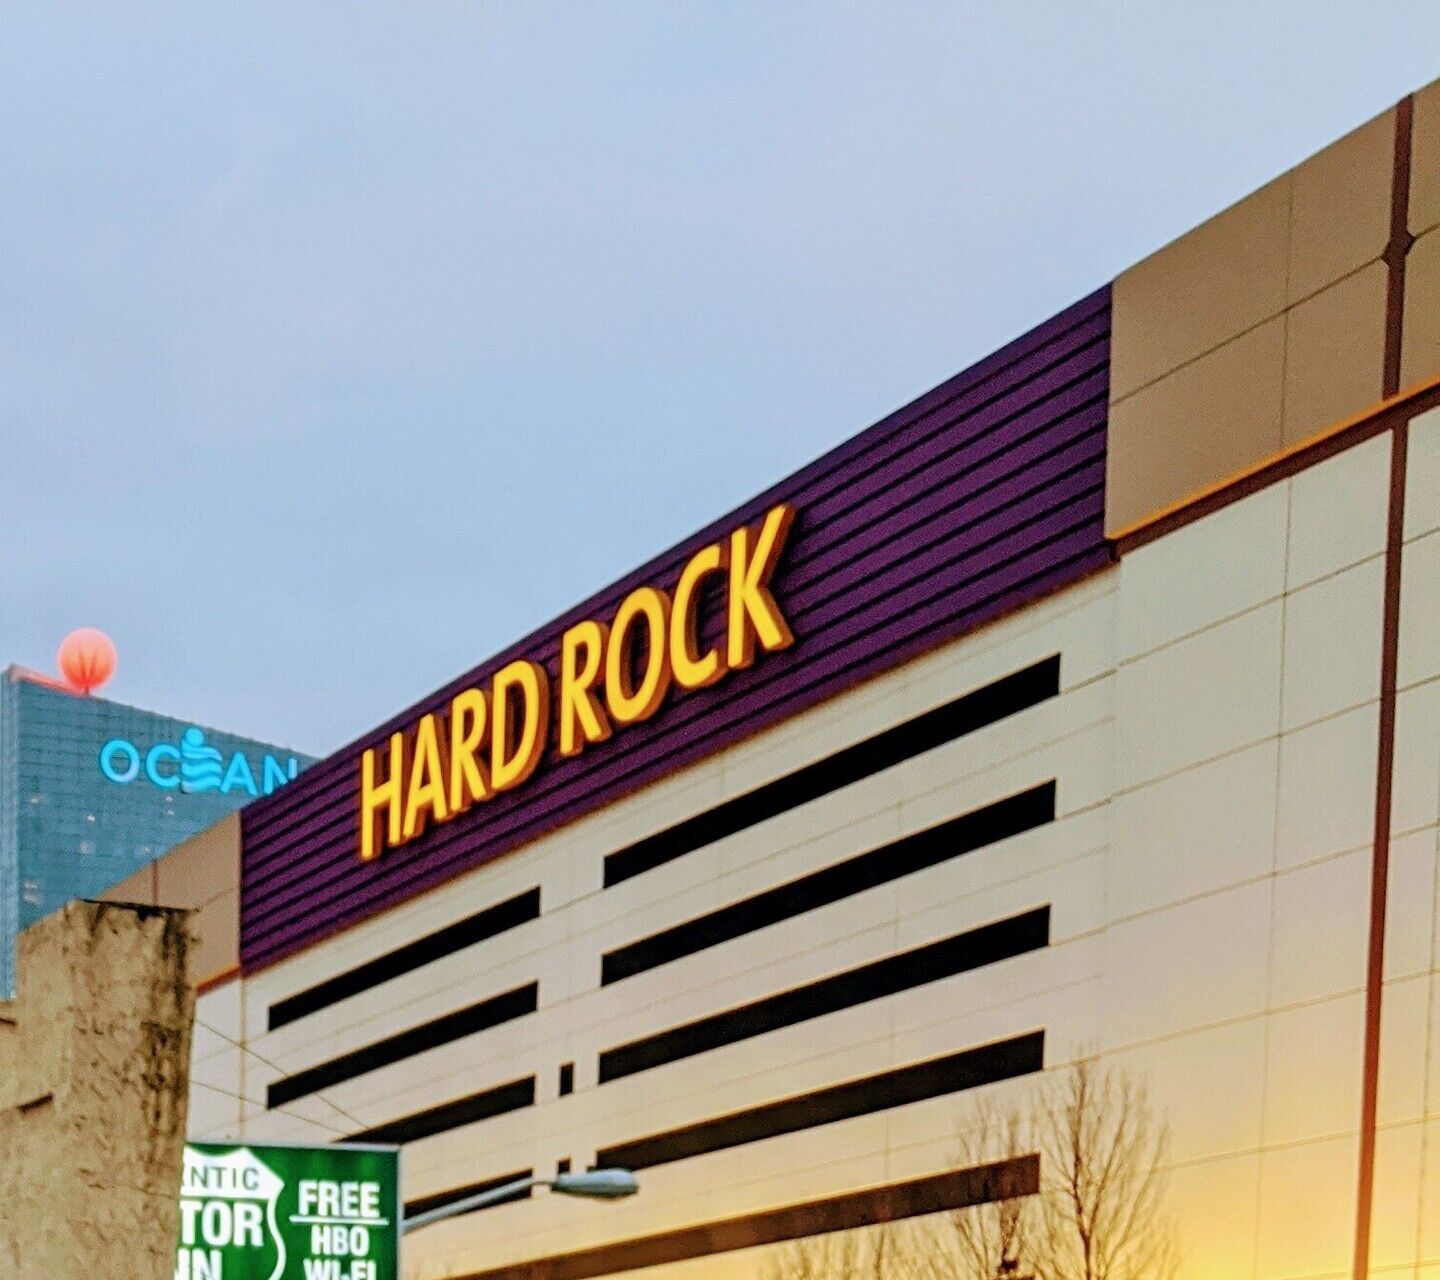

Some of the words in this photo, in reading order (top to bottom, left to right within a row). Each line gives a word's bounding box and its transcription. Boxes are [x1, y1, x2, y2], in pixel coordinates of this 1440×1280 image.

[359, 659, 549, 861] HARD
[560, 502, 797, 755] ROCK
[190, 1165, 260, 1191] NTIC
[298, 1179, 381, 1219] FREE
[179, 1200, 265, 1248] TOR
[311, 1223, 370, 1257] HBO
